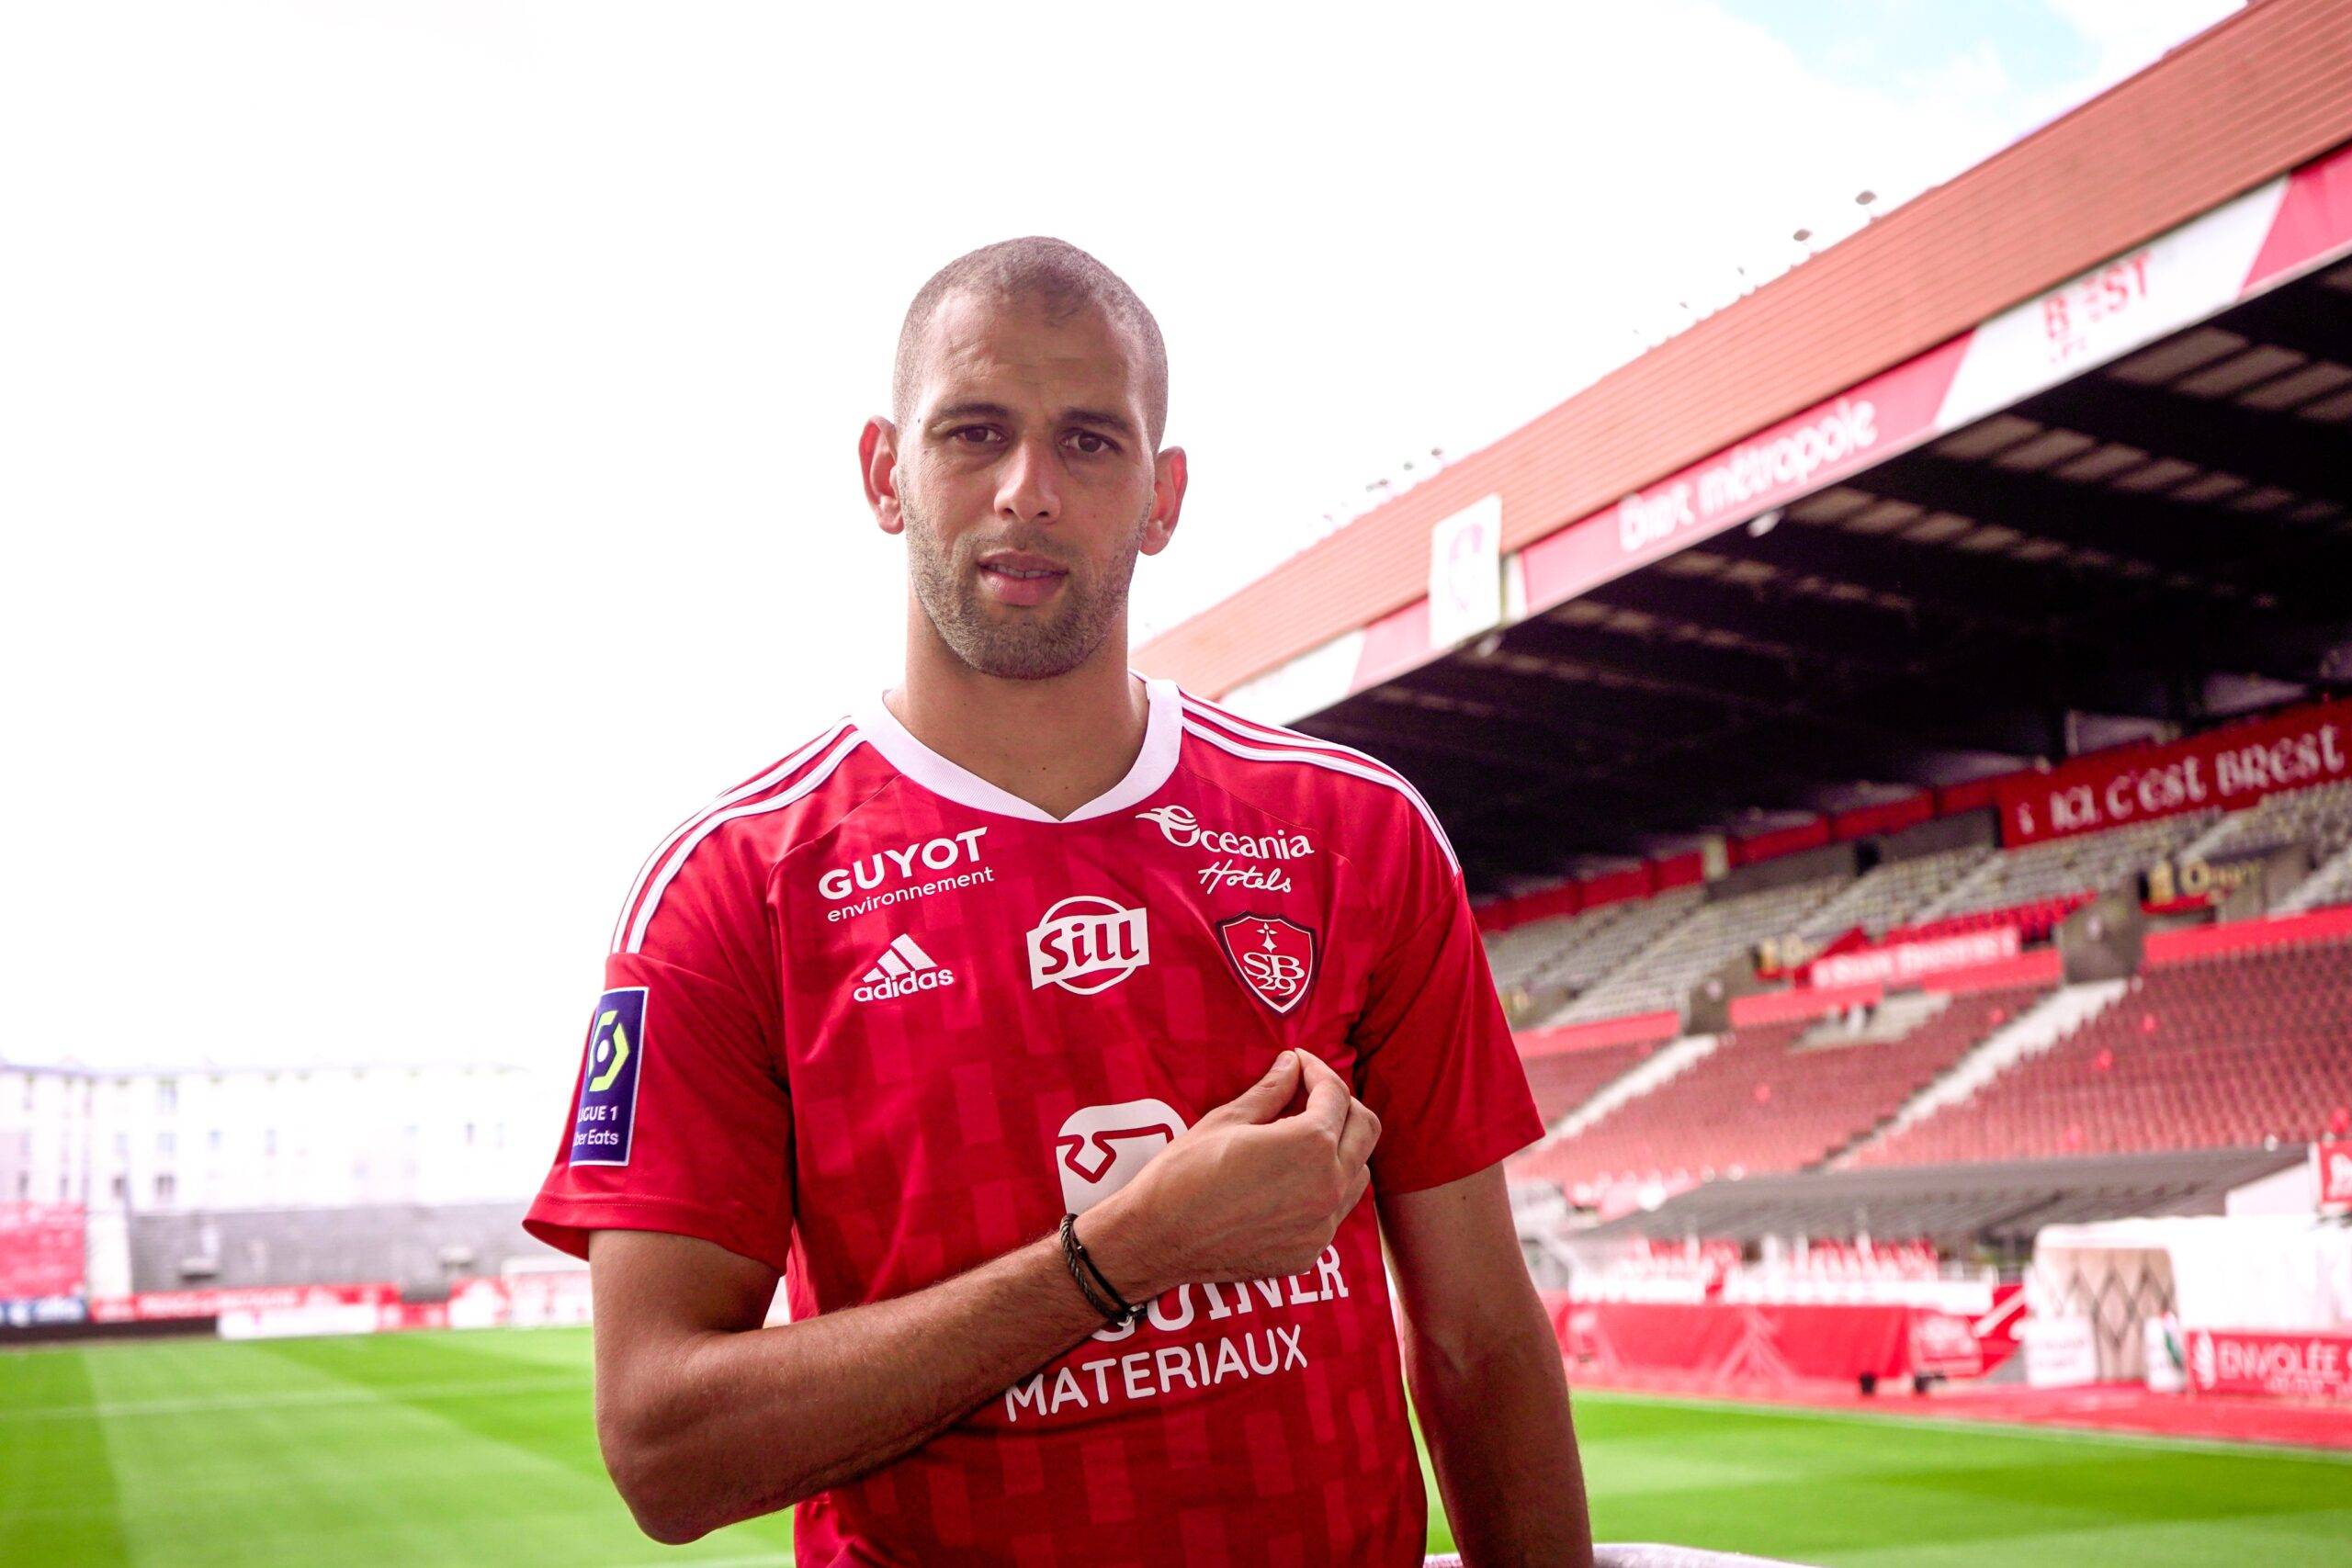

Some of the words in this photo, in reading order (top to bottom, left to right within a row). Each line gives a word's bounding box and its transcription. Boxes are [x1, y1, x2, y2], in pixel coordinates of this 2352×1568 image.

[1139, 805, 1316, 860] Oceania
[819, 827, 988, 900] GUYOT
[1198, 859, 1292, 895] Hotels
[827, 866, 995, 922] environnement
[1039, 919, 1140, 976] Sill
[1243, 952, 1306, 980] SB
[854, 969, 956, 1002] adidas
[1257, 976, 1297, 997] 29
[610, 1105, 619, 1122] 1
[587, 1128, 620, 1145] Eats
[1091, 1243, 1350, 1343] UINER
[1004, 1324, 1308, 1423] MATERIAUX
